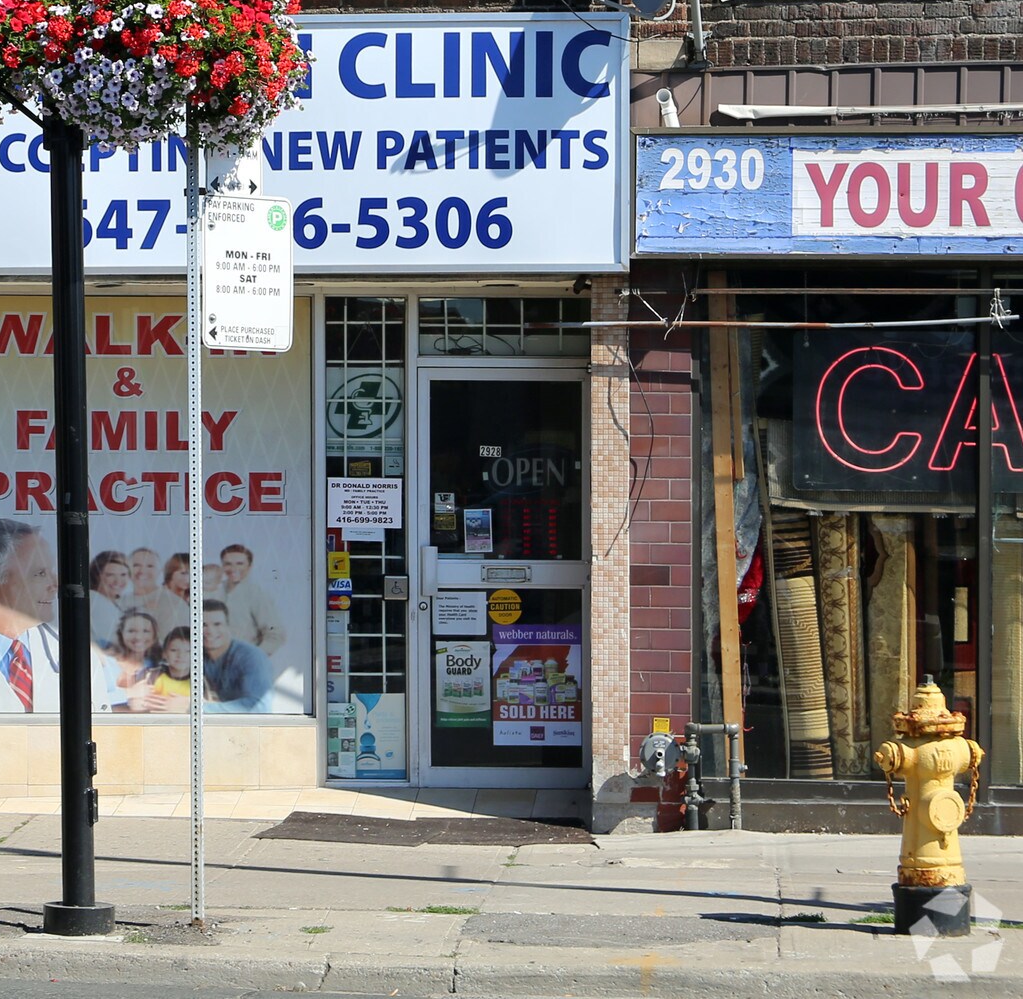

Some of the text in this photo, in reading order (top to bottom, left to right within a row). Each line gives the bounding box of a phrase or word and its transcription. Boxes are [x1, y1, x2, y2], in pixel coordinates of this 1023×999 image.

[338, 30, 610, 99] CLINIC
[378, 129, 609, 171] PATIENTS
[659, 147, 765, 191] 2930
[804, 161, 991, 228] YOUR
[207, 200, 255, 212] PAY PARKING
[207, 212, 246, 223] ENFORCED
[225, 250, 248, 260] MON
[256, 252, 271, 261] FRI
[233, 262, 246, 271] AM
[252, 263, 267, 273] 6:00
[268, 264, 281, 274] PM
[239, 274, 257, 284] SAT
[233, 285, 246, 295] AM
[252, 287, 267, 296] 6:00
[268, 288, 281, 297] PM
[220, 325, 275, 336] PLACE PURCHASED
[224, 334, 245, 344] TICKET
[255, 336, 271, 345] DASH
[112, 366, 144, 398] &
[16, 410, 238, 451] FMILY
[480, 446, 502, 457] 2928
[491, 457, 566, 487] OPEN
[336, 516, 394, 524] 416-699-9823
[331, 580, 351, 589] VISA
[490, 603, 520, 611] CAUTION
[498, 629, 534, 640] webber
[446, 654, 482, 670] Body
[446, 667, 472, 675] GUARD
[499, 704, 575, 719] SOLD HERE
